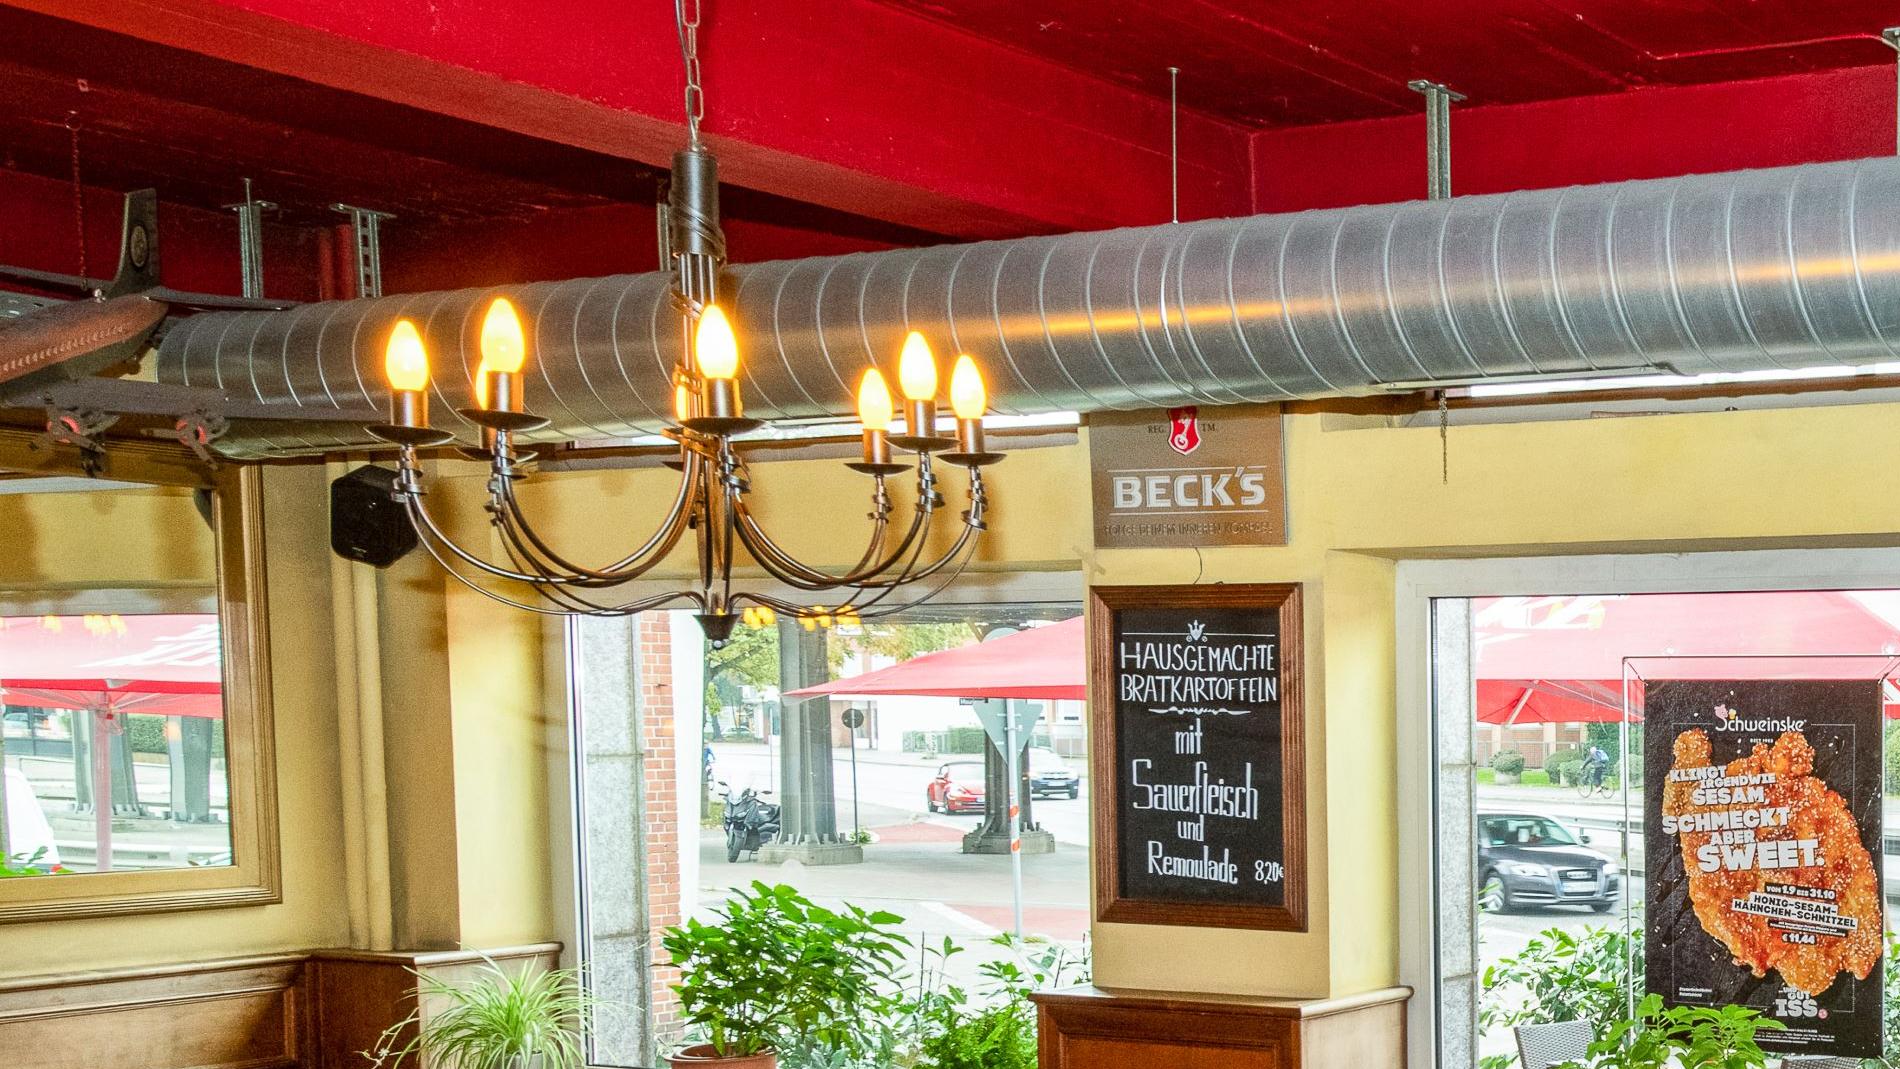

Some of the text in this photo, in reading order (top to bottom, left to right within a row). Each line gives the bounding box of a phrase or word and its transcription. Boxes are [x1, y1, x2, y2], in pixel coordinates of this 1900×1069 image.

[1112, 466, 1266, 509] BECK'S
[1120, 642, 1275, 672] HAUSGEMACHTE
[1121, 674, 1278, 703] BRATKARTOFFELN
[1175, 718, 1203, 755] mit
[1715, 715, 1805, 732] Schweinske
[1669, 766, 1727, 783] KLINGT
[1700, 773, 1777, 789] IRGENDWIE
[1132, 759, 1259, 820] Sauerfleisch
[1692, 786, 1770, 806] SESAM,
[1177, 814, 1205, 842] und
[1662, 807, 1790, 835] SCHMECKT
[1711, 829, 1756, 845] ABER
[1148, 840, 1239, 884] Remoulade
[1697, 839, 1826, 873] SWEET.
[1734, 899, 1857, 928] HÄHNCHEN-SCHNITZEL
[1754, 894, 1837, 915] HONIG-SESAM-
[1775, 998, 1818, 1017] ISS
[1787, 990, 1811, 1000] GUT
